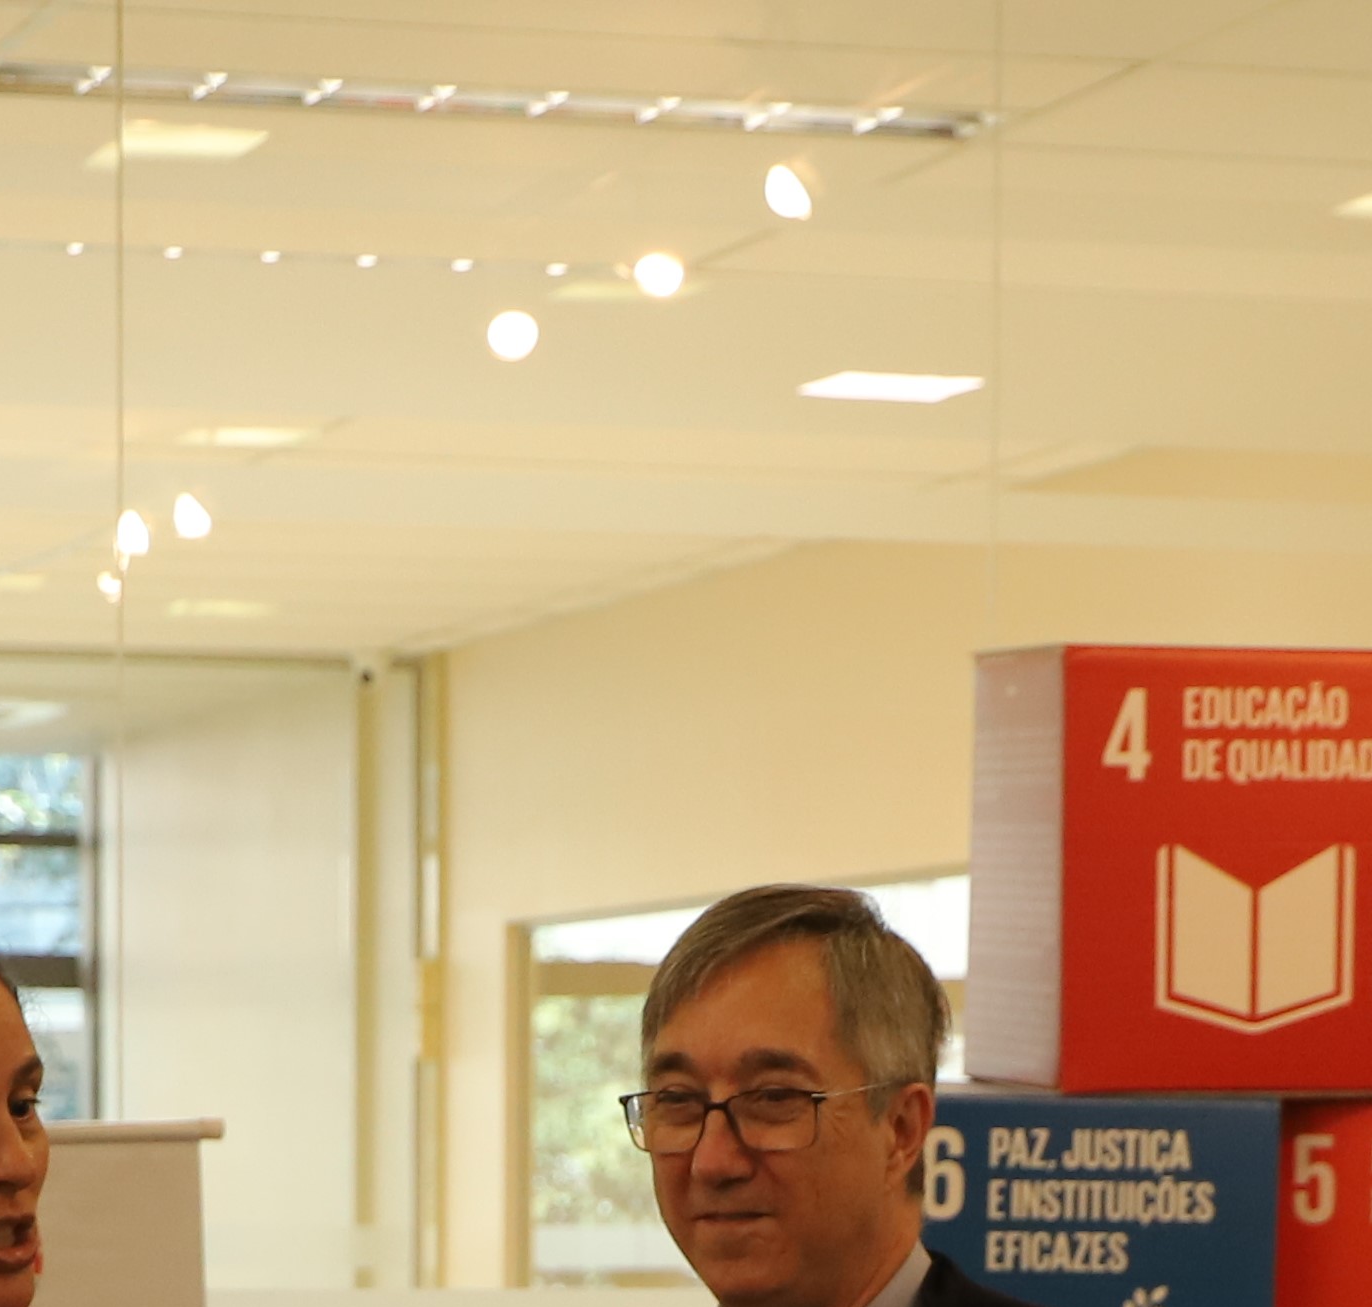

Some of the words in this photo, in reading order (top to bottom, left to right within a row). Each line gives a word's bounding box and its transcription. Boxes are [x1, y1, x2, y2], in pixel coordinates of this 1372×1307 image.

[1182, 680, 1350, 733] EDUCAÇÃO
[1101, 686, 1153, 782] 4
[1181, 739, 1224, 781] DE
[922, 1125, 966, 1222] 6
[1060, 1128, 1193, 1174] JUSTIÇA
[986, 1178, 1007, 1221] E
[1009, 1174, 1217, 1226] INSTITUIÇÕES
[1292, 1133, 1337, 1225] 5
[985, 1230, 1129, 1273] EFICAZES
